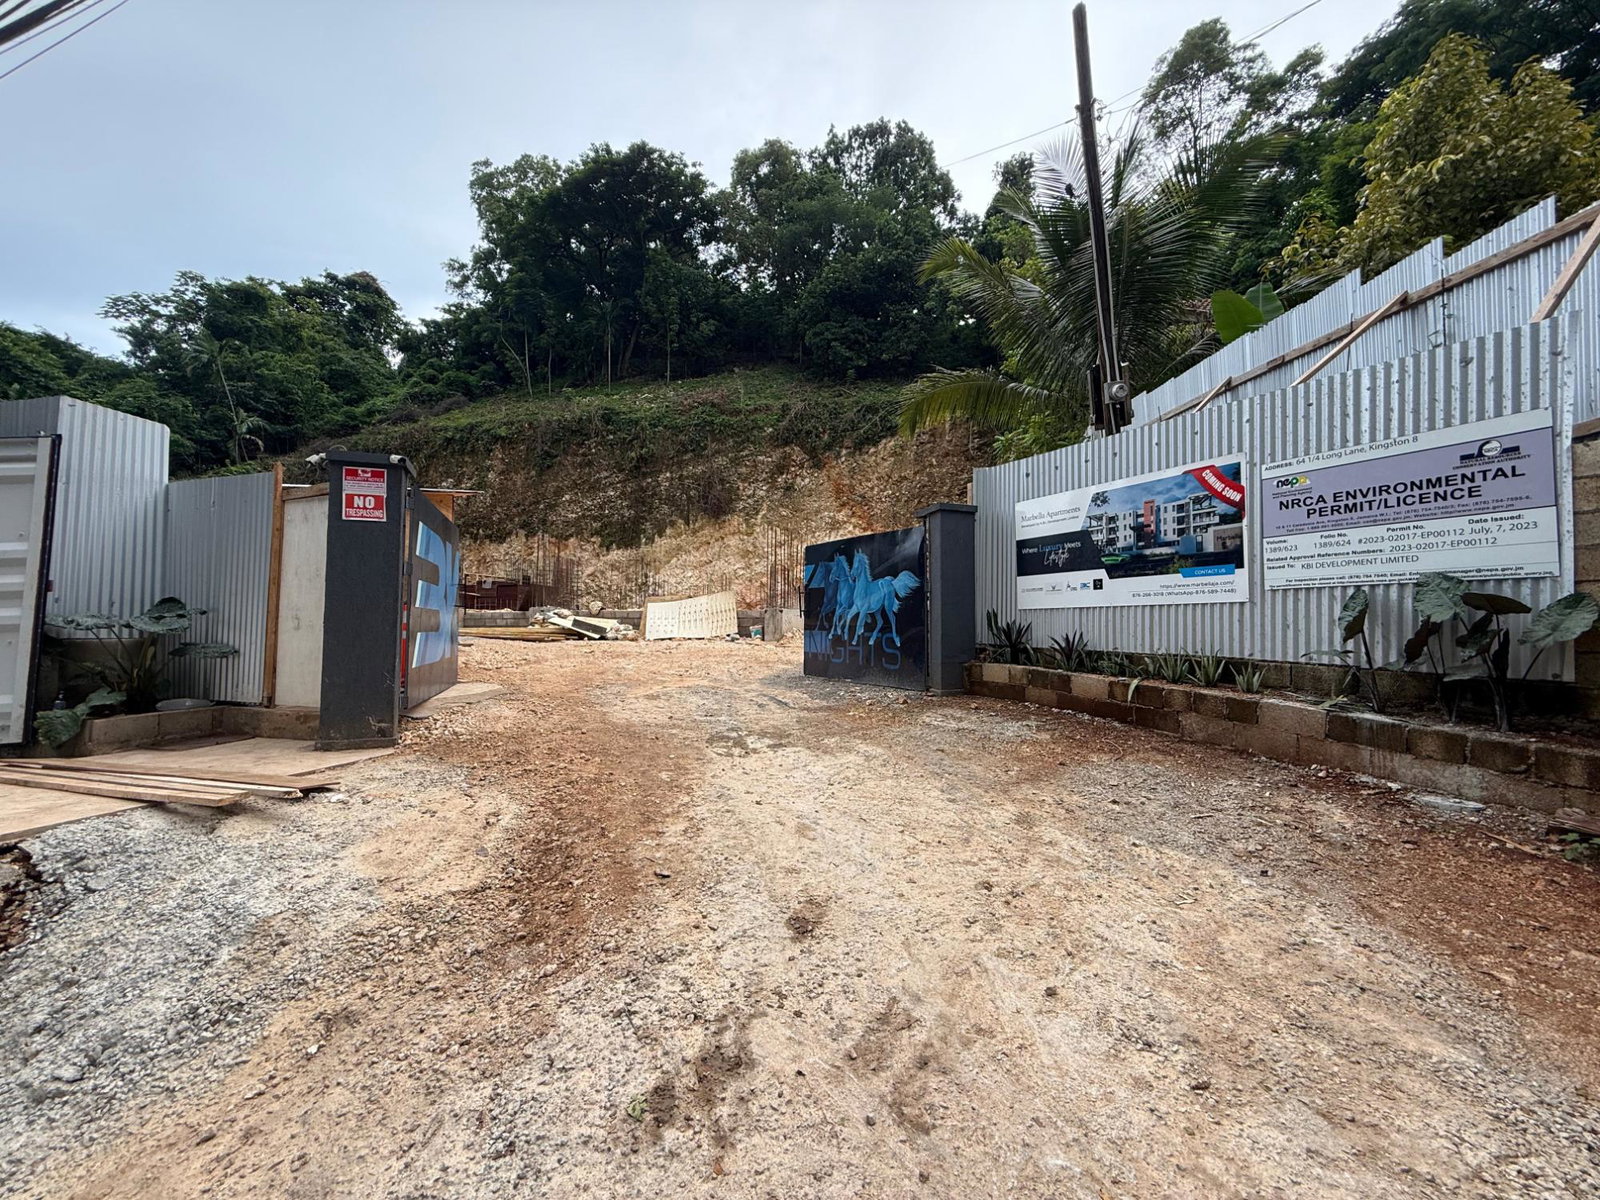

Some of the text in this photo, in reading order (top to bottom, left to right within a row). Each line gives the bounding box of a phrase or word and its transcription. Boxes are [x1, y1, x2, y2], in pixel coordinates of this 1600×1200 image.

[1264, 435, 1418, 471] ADDRESS: 64 1/4 Long Lane, Kingston 8
[1202, 469, 1243, 503] COMING SOON
[1276, 475, 1308, 489] nepa
[1279, 465, 1526, 511] NRCA ENVIRONMENTAL
[353, 495, 375, 508] NO
[1306, 485, 1482, 519] PERMIT/LICENCE
[346, 508, 384, 518] TRESPASSING
[1020, 506, 1081, 522] Marbella Apartments
[1386, 524, 1411, 533] Permit
[1412, 523, 1426, 531] No.
[1468, 516, 1488, 525] Date
[1490, 513, 1525, 523] Issued:
[1021, 541, 1081, 554] Where Luxury Meets
[1265, 521, 1538, 555] 1389/623 1389/624 #2023-02017-EP00112 July, 7, 2023
[1288, 553, 1316, 561] Approval
[1316, 550, 1350, 558] Reference
[1351, 548, 1386, 556] Numbers:
[1389, 536, 1498, 553] 2023-02017-EP00112
[1301, 562, 1314, 570] KBI
[1315, 557, 1379, 569] DEVELOPMENT
[1380, 554, 1419, 564] LIMITED
